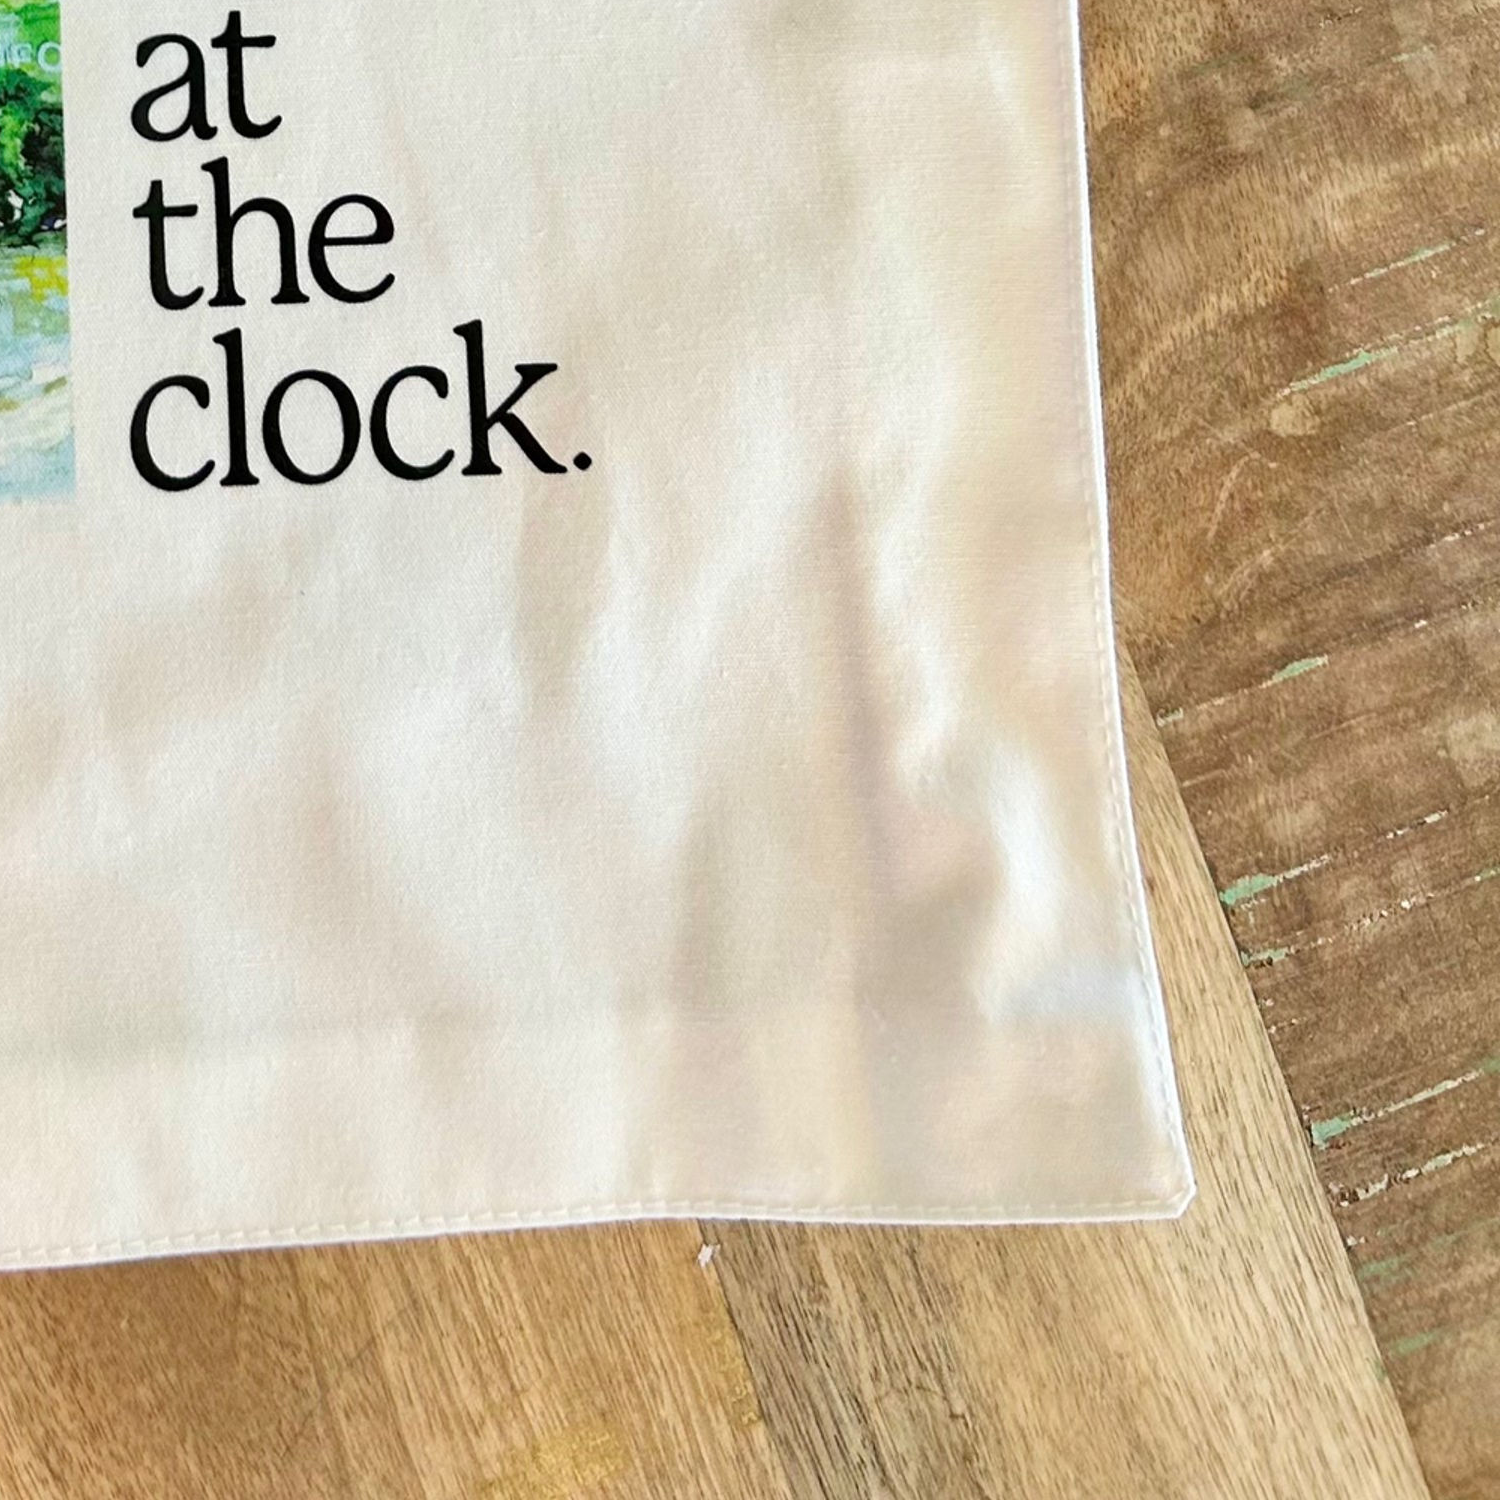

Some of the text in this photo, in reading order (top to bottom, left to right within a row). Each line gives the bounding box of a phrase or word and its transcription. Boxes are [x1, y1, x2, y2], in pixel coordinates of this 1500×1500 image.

[130, 10, 283, 143] at
[132, 156, 396, 311] the
[129, 319, 593, 493] clock.
